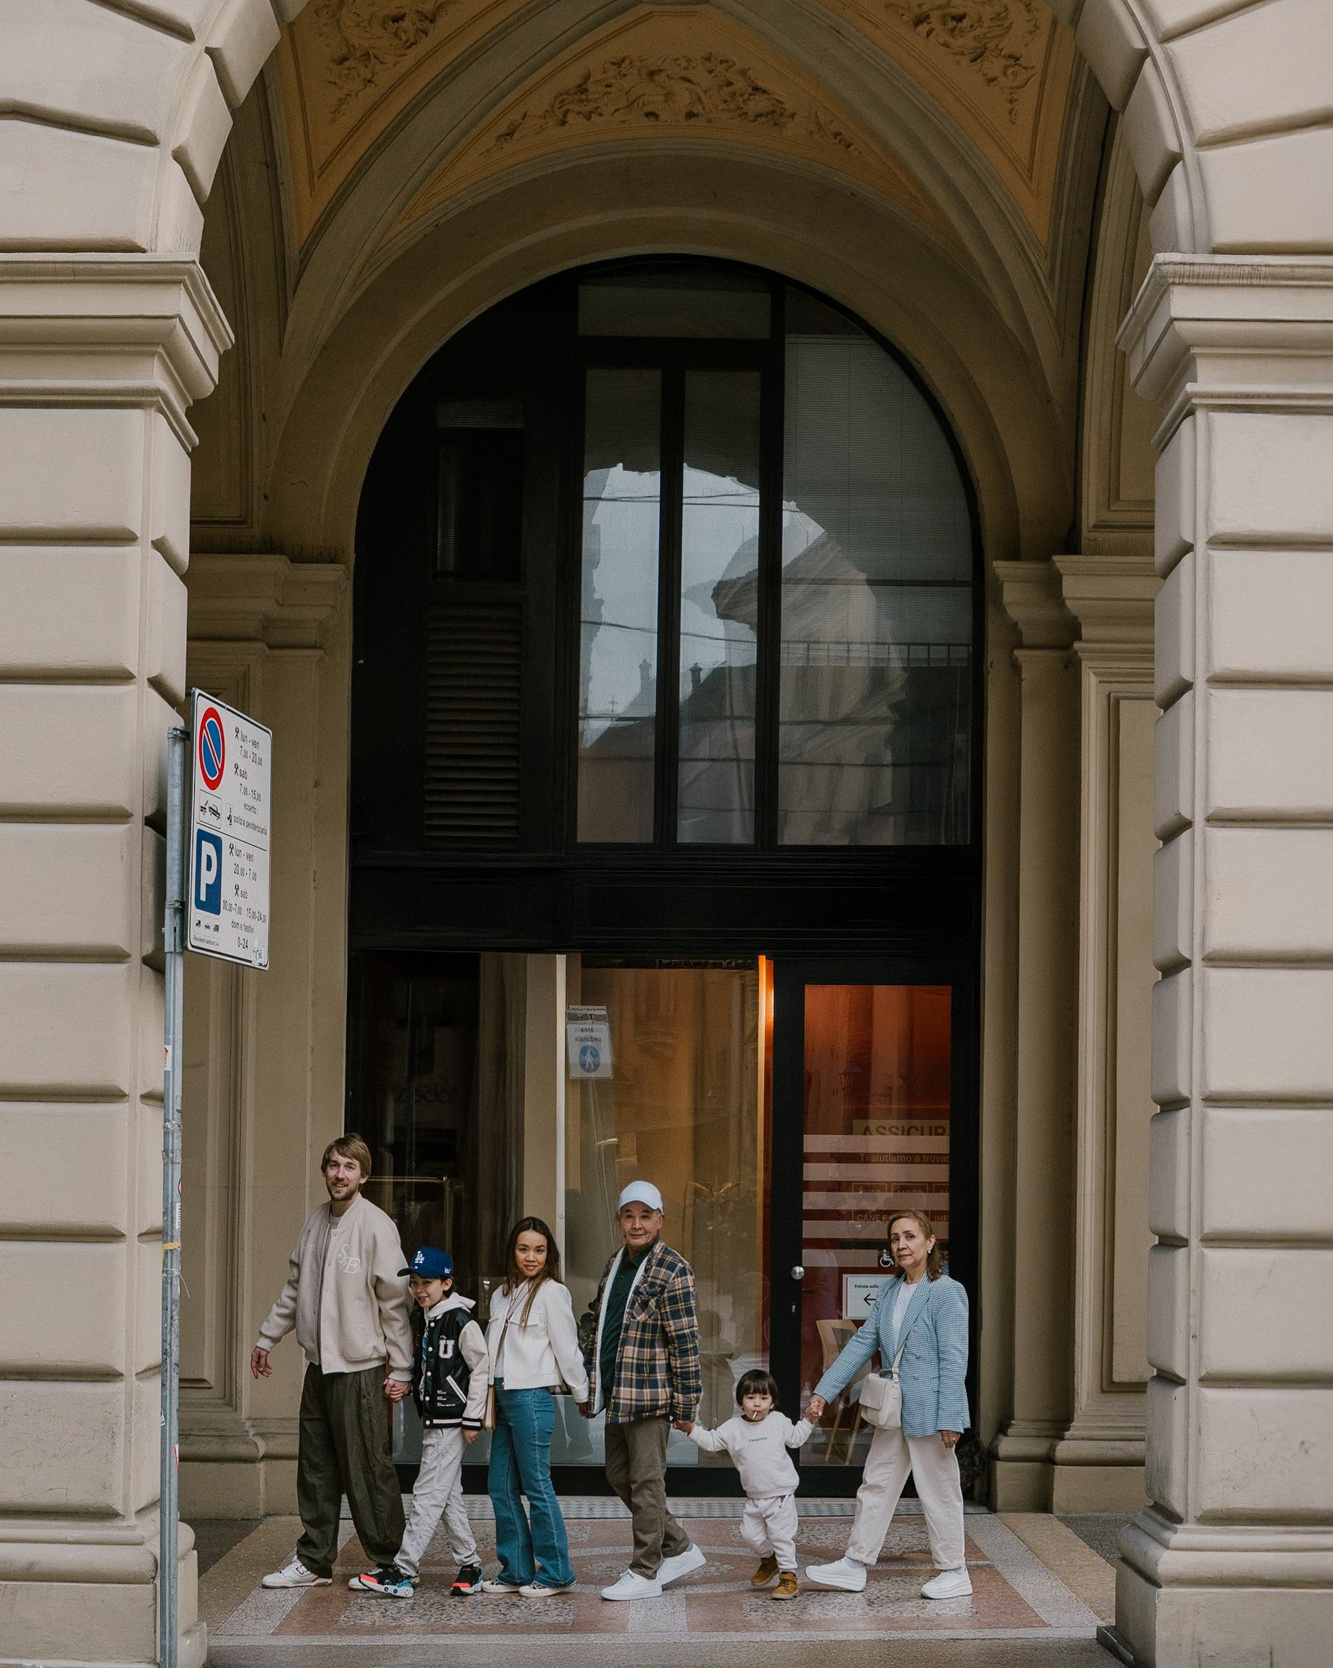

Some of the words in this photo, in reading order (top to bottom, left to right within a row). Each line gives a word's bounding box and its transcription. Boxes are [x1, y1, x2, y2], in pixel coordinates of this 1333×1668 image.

[251, 738, 260, 749] ven
[239, 768, 248, 780] sab
[246, 853, 254, 863] ven
[200, 840, 217, 901] P
[871, 1153, 912, 1163] aiutiamo
[414, 1251, 425, 1264] LA
[439, 1340, 455, 1359] U
